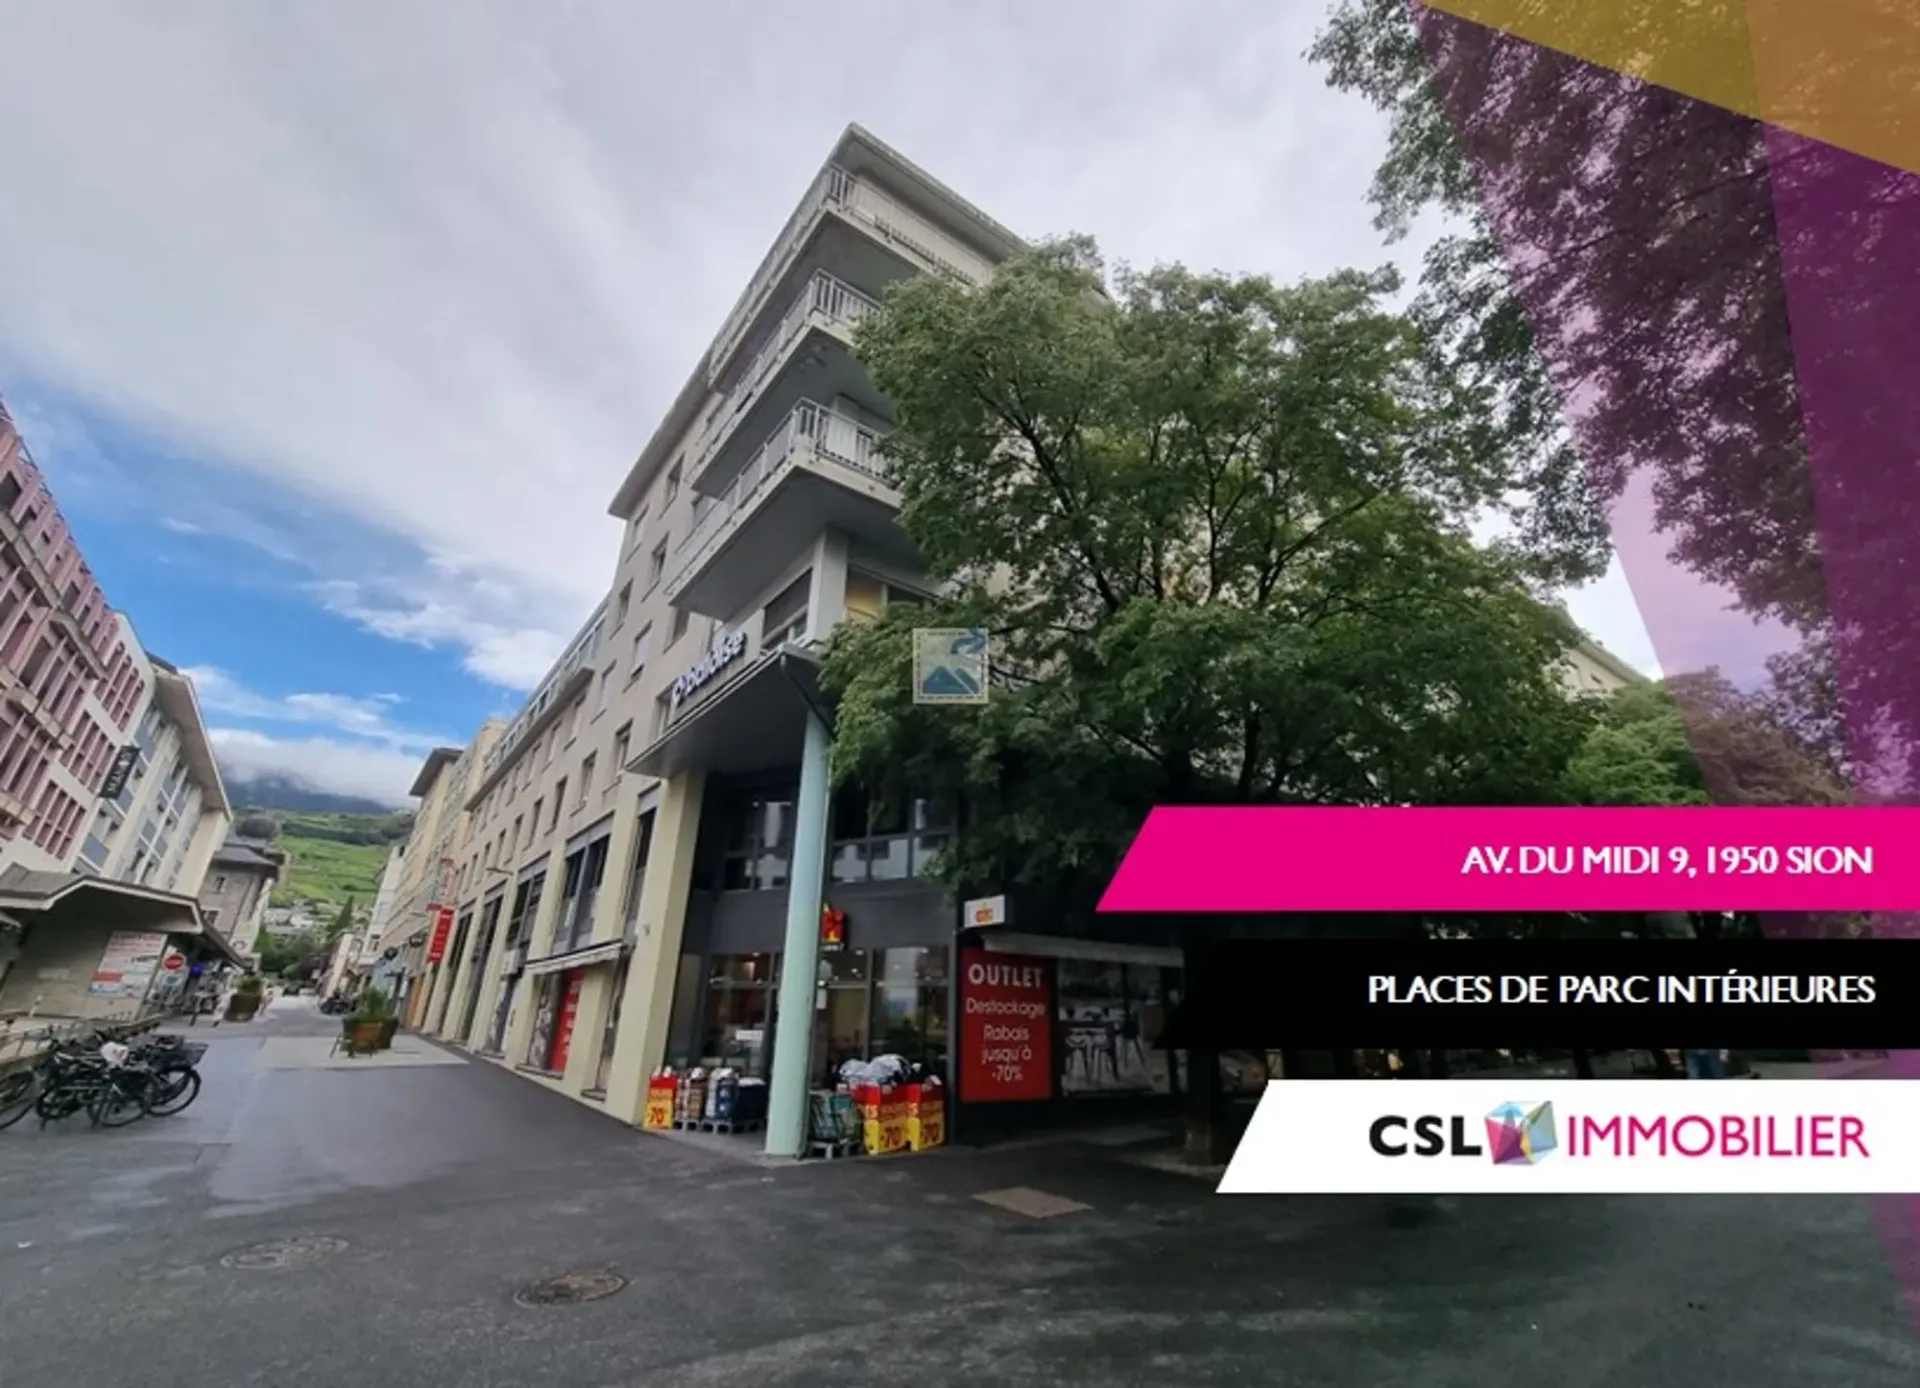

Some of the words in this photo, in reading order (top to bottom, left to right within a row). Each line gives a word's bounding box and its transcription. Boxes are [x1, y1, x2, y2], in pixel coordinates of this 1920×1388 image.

[968, 963, 1043, 988] OUTLET
[966, 997, 1045, 1019] Destockage
[984, 1024, 1030, 1041] Rabais
[982, 1043, 1032, 1065] jusqu'à
[991, 1065, 1024, 1083] -70%
